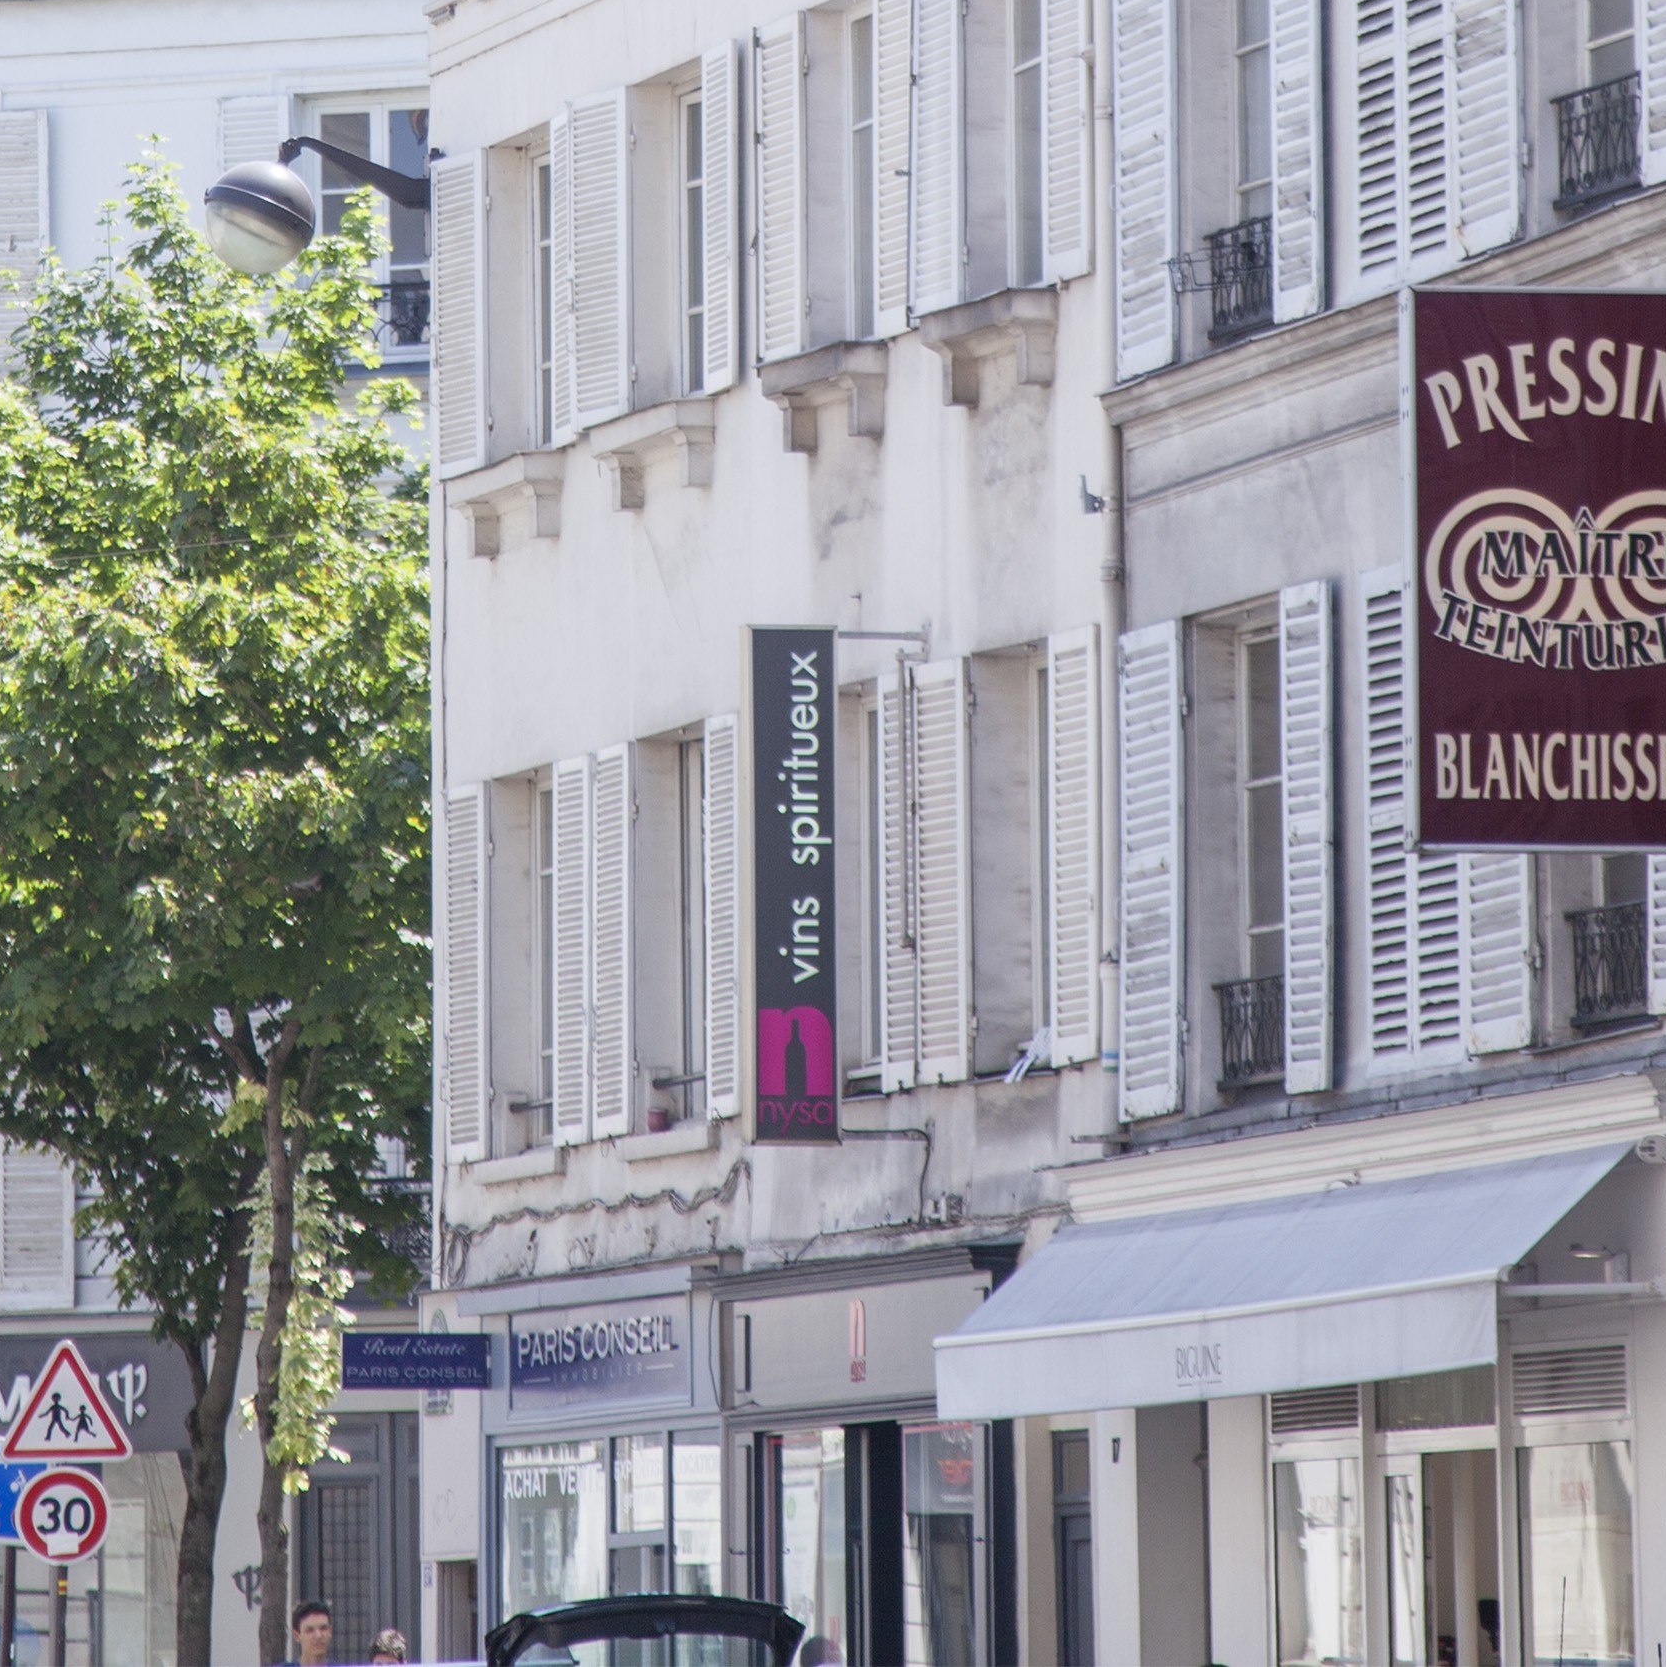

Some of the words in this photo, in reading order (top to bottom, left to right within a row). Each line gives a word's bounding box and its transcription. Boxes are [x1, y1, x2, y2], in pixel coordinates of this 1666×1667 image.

[776, 650, 832, 867] spiritueux
[778, 896, 821, 985] vins
[758, 1099, 834, 1134] nysa
[363, 1338, 411, 1356] Real
[412, 1338, 466, 1356] Estate
[518, 1325, 576, 1369] PARIS
[580, 1315, 671, 1362] CONSEIL
[1175, 1342, 1223, 1380] BIGUINE
[346, 1366, 400, 1379] PARIS
[404, 1366, 483, 1379] CONSEIL
[503, 1467, 548, 1500] ACHAT
[36, 1496, 92, 1536] 30
